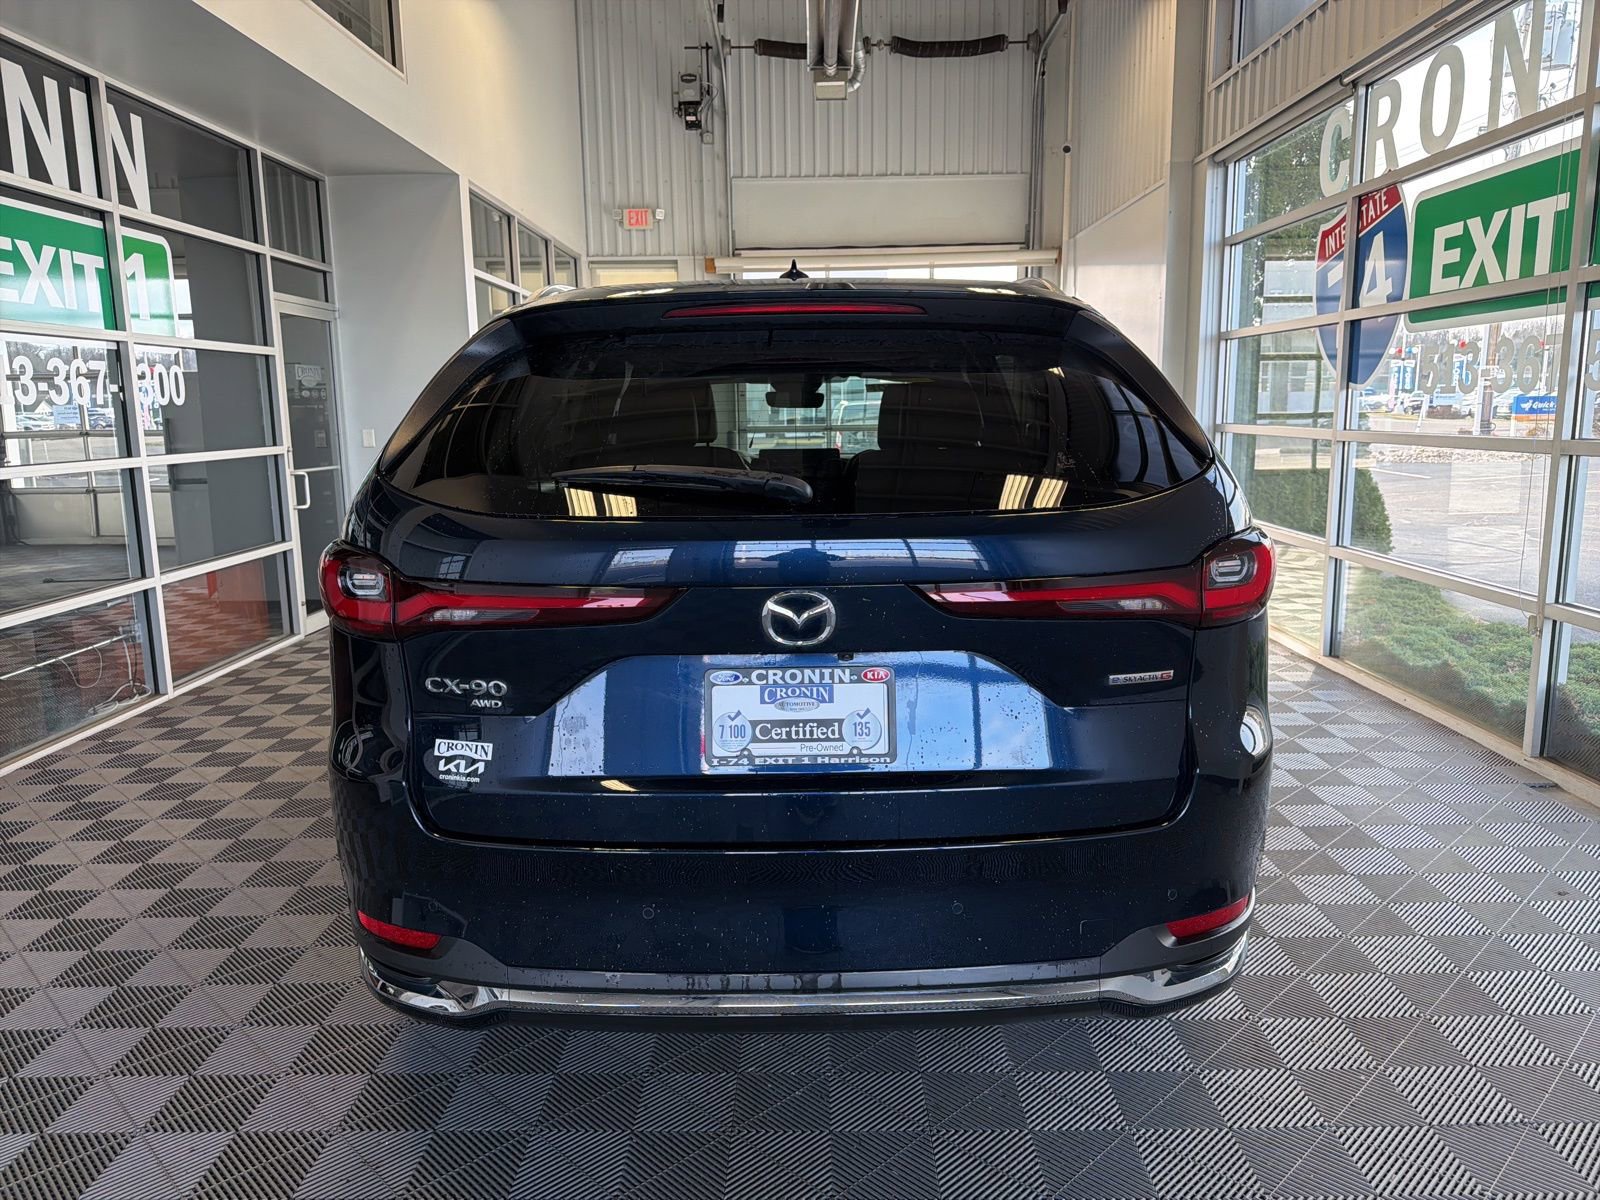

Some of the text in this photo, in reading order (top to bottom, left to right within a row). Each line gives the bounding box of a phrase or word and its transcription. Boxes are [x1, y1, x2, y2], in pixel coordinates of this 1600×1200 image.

[628, 210, 649, 227] EXIT
[1430, 192, 1570, 297] EXIT
[0, 236, 150, 320] EXIT 1
[751, 668, 850, 685] CRONIN
[867, 670, 887, 680] KIA
[425, 677, 507, 697] CX-90
[764, 686, 829, 703] CRONIN
[470, 699, 502, 708] AWD
[729, 724, 746, 740] 100
[755, 723, 840, 740] Certified
[853, 722, 871, 738] 135
[437, 741, 491, 759] CRONIN
[800, 743, 844, 752] Pre-Owned
[711, 755, 890, 766] I-74 EXIT 1 Harrison
[439, 774, 480, 783] croninkia.com
